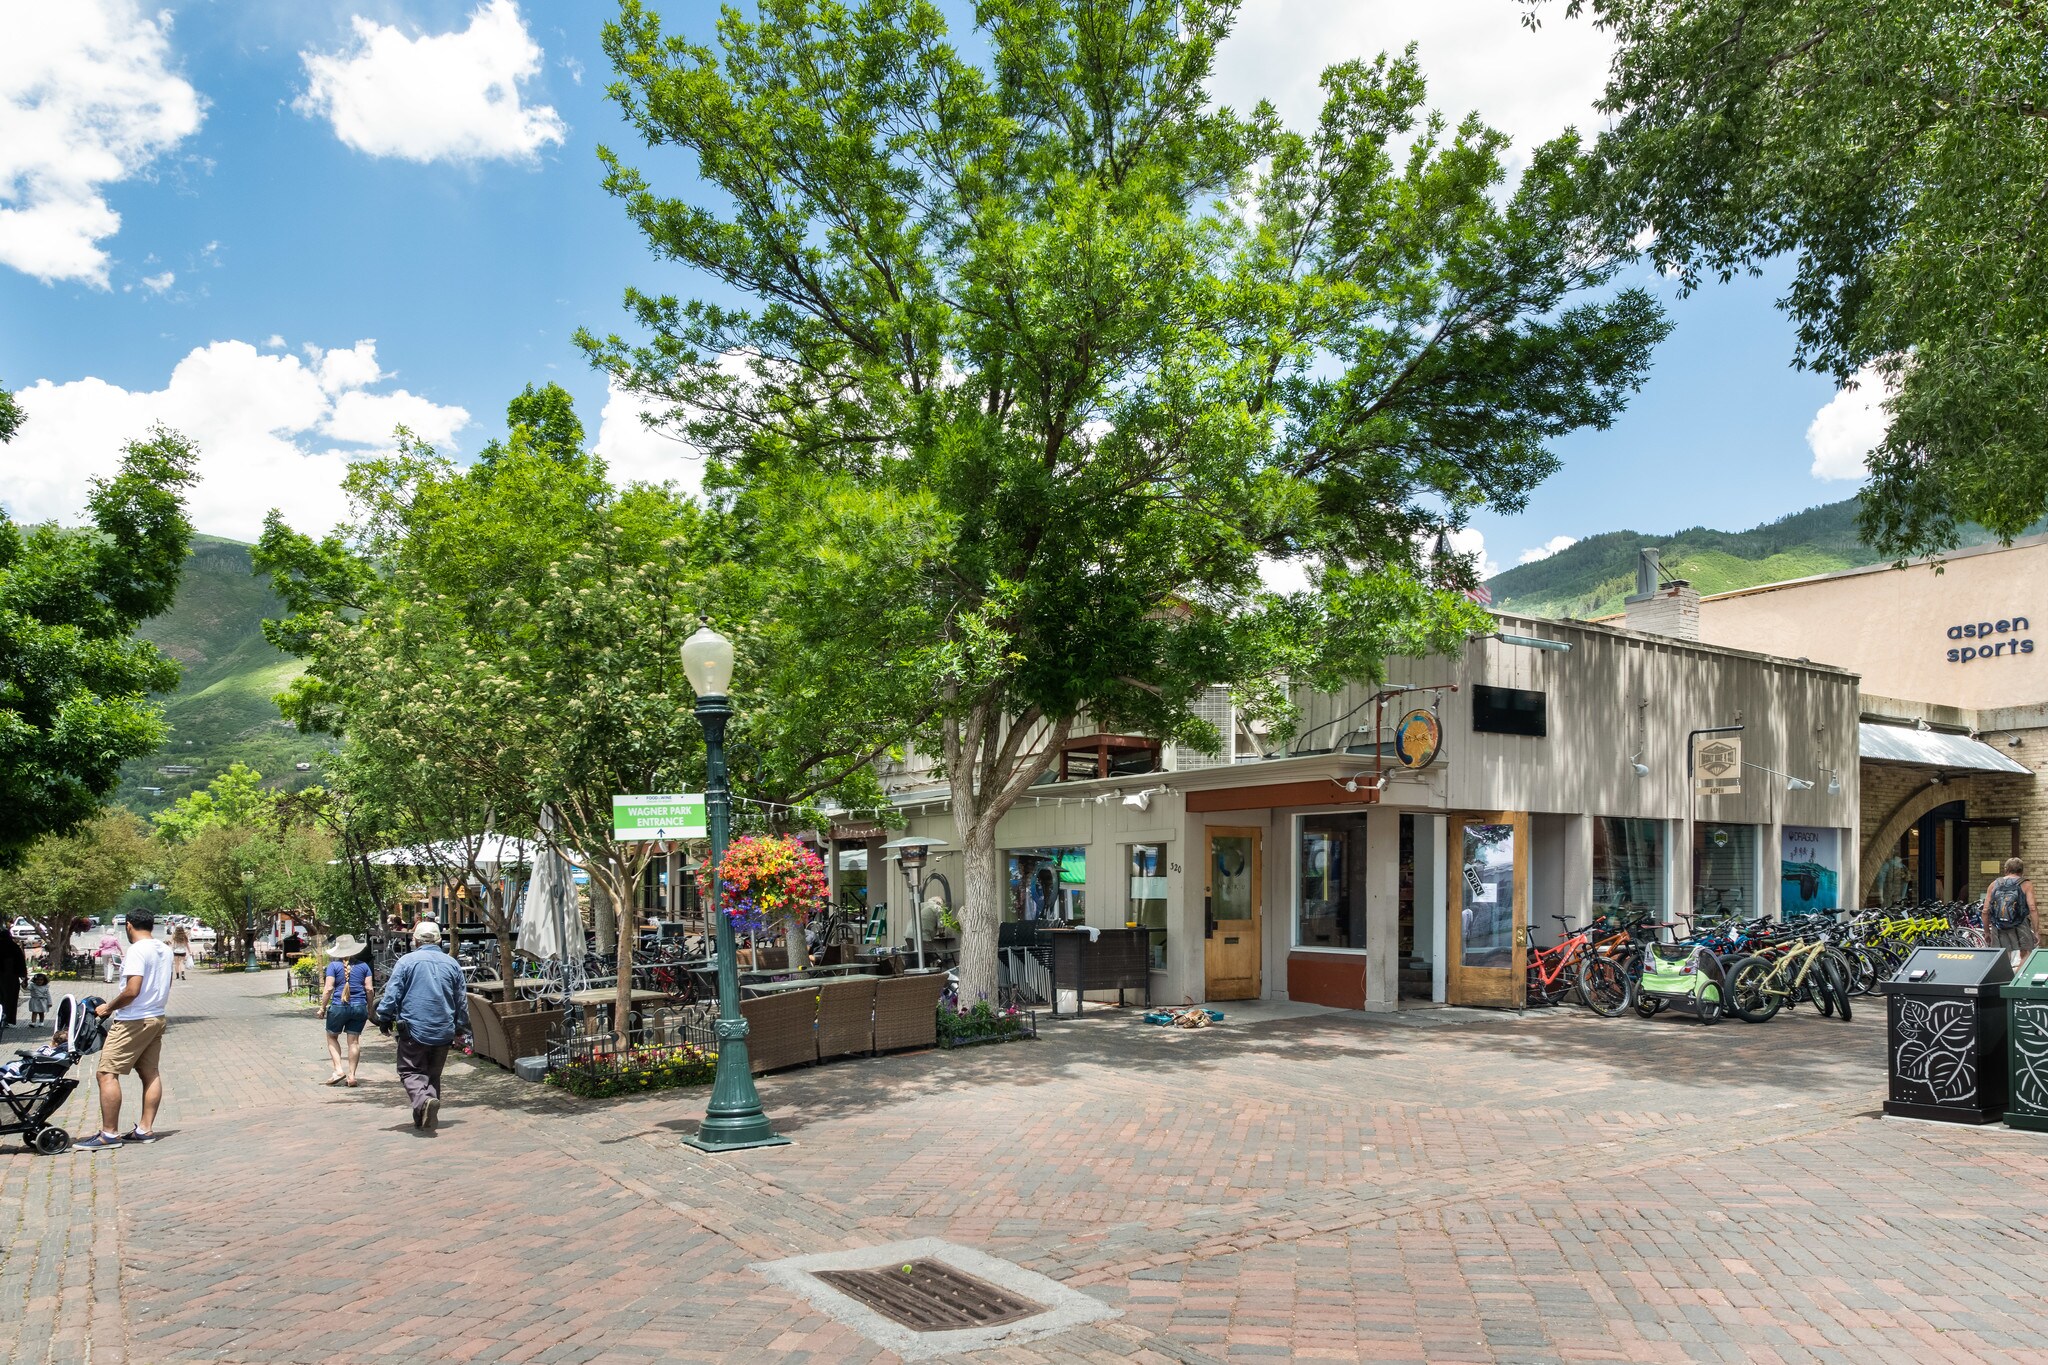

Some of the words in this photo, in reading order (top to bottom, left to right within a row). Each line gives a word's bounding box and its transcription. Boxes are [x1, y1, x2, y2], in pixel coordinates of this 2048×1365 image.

[1947, 617, 2029, 640] aspen
[1947, 638, 2034, 663] sports
[628, 807, 668, 817] WAGNER
[670, 806, 693, 815] PARK
[637, 817, 684, 827] ENTRANCE
[1794, 831, 1819, 842] DRAGON
[1466, 871, 1483, 894] OPEN
